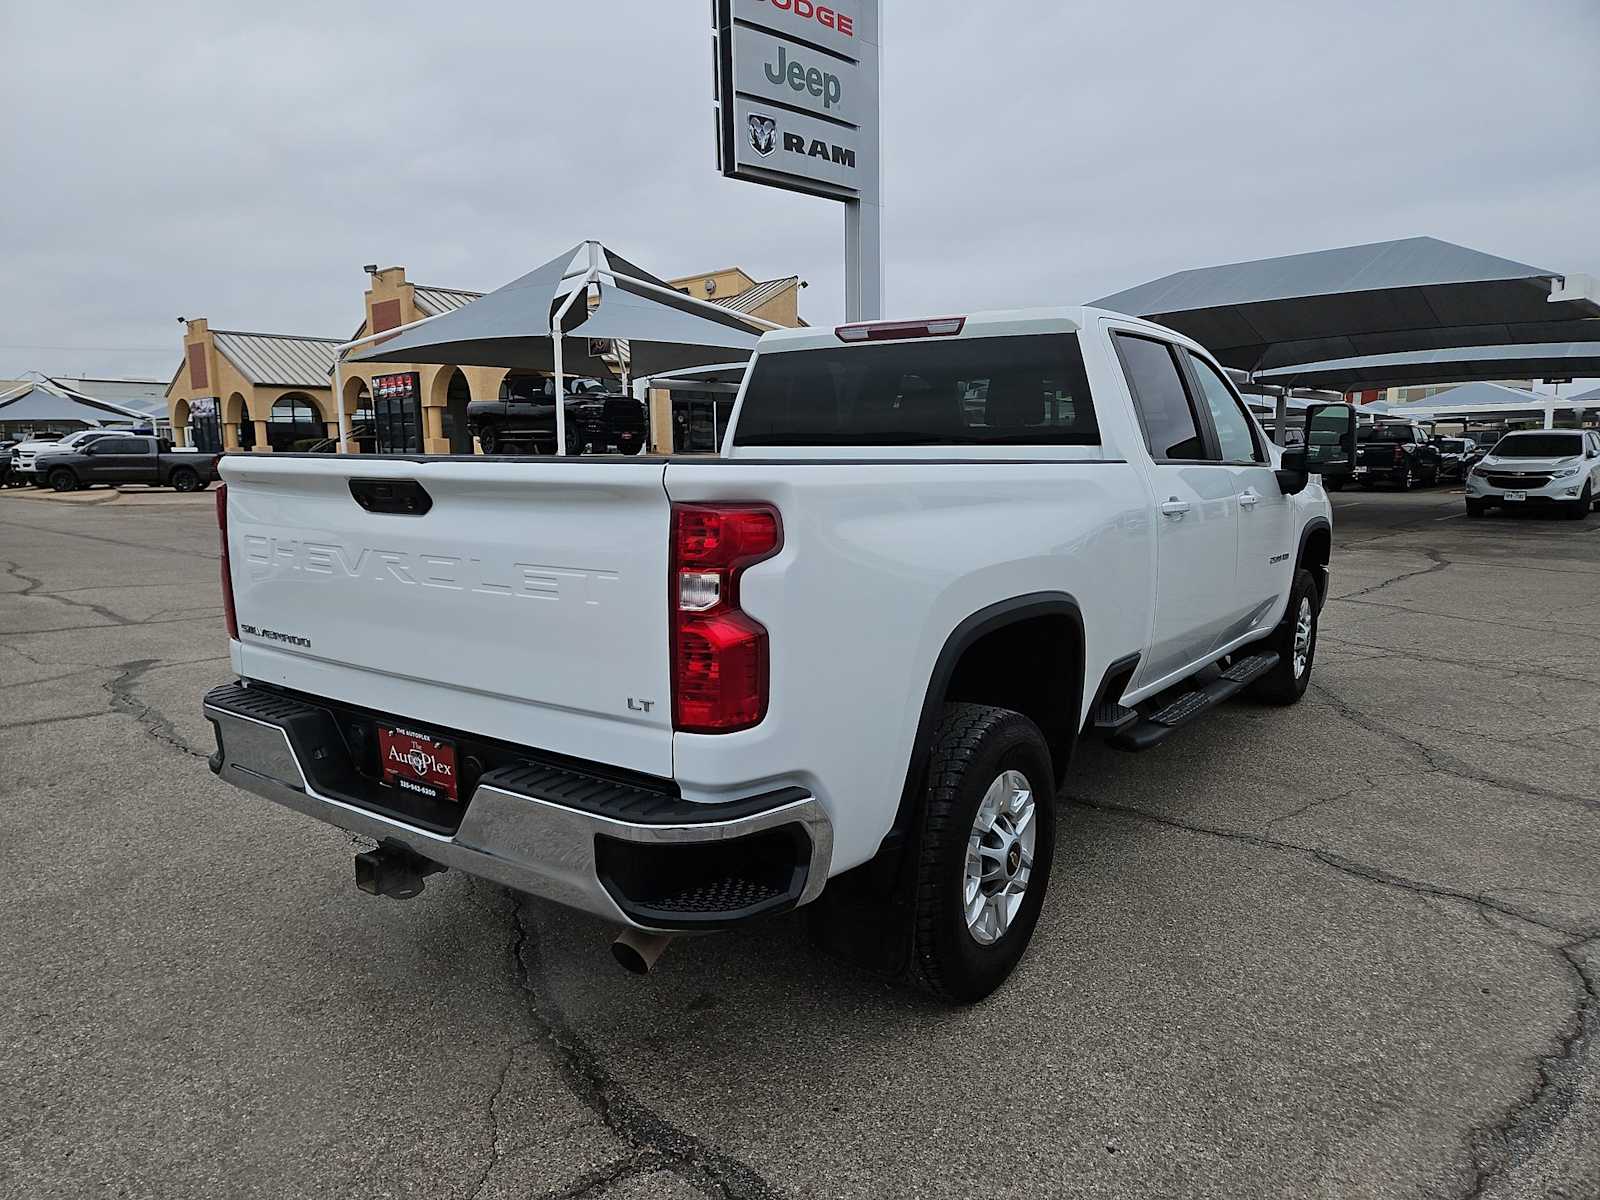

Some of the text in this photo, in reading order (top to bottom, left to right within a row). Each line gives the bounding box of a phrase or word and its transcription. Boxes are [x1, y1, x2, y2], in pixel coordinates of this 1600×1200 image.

[764, 46, 841, 109] Jeep
[783, 131, 856, 168] RAM
[243, 534, 620, 605] CHEVROLET
[240, 623, 312, 649] SILVERADO
[627, 697, 655, 713] LT
